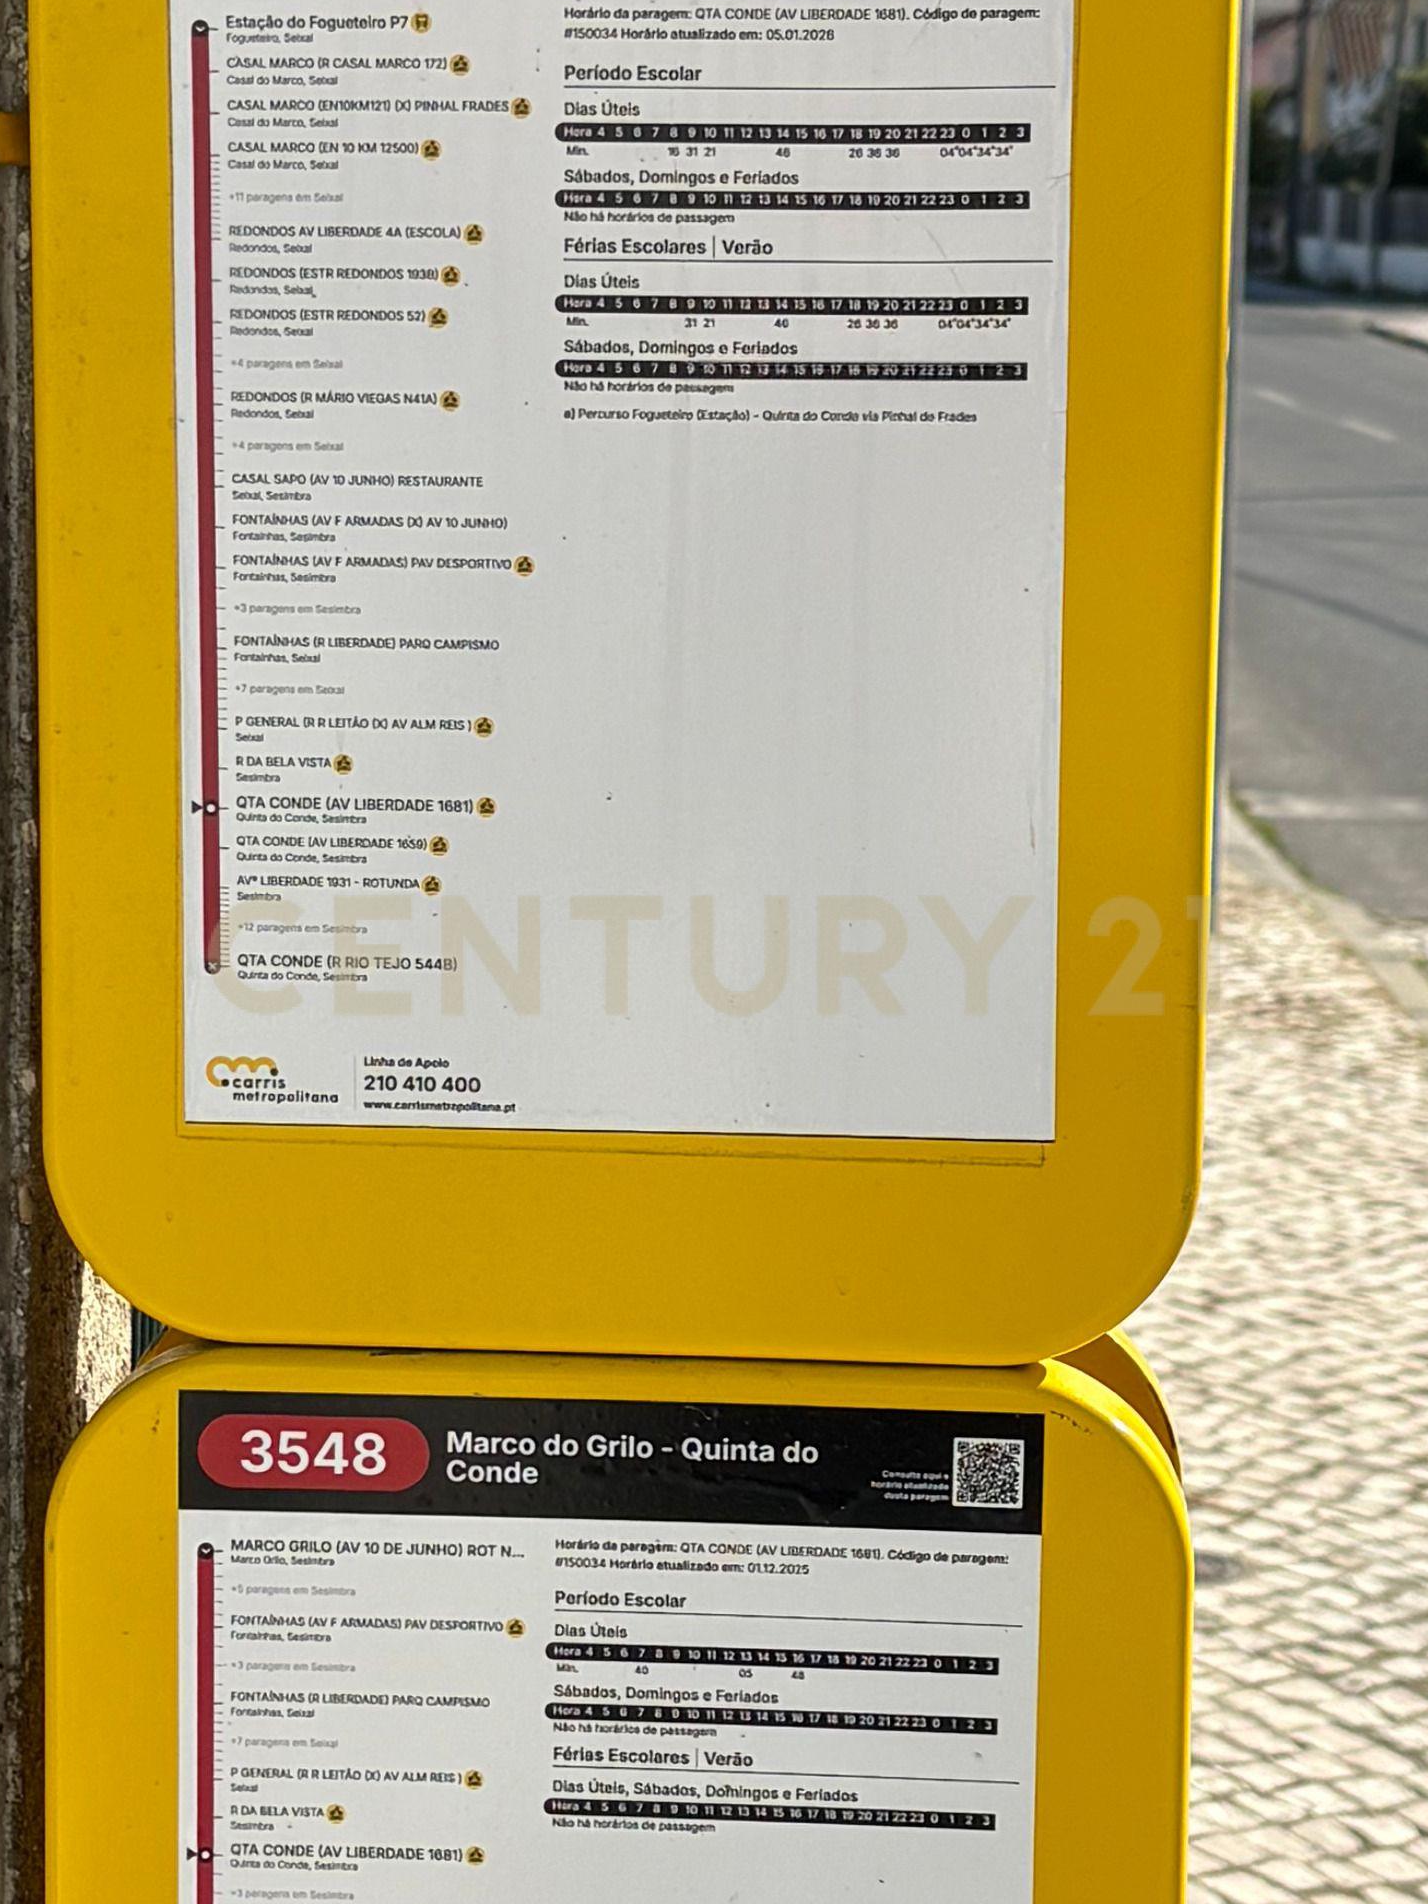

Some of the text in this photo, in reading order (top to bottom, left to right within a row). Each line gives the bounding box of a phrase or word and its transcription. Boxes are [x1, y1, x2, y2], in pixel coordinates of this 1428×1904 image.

[226, 14, 408, 32] Estação do Fogueteiro P7
[565, 65, 702, 81] Período Escolar
[564, 169, 799, 187] Sábados, Domingos e Feriados
[565, 237, 773, 255] Férias Escolares Verão
[235, 795, 473, 814] QTA CONDE (AV LIBERDADE 1681)
[364, 1056, 449, 1070] Linha de Apoio
[233, 1075, 286, 1093] carris
[364, 1075, 481, 1093] 210 410 400
[233, 1090, 338, 1104] metropolitana
[241, 1429, 386, 1475] 3548
[447, 1431, 535, 1463] Marco
[543, 1433, 578, 1456] do
[587, 1434, 653, 1459] Grilo
[682, 1437, 774, 1462] Quinta
[783, 1441, 818, 1463] do
[447, 1460, 538, 1484] Conde
[231, 1539, 524, 1558] MARCO GRILO (AV 10 DE JUNHO) ROT N...
